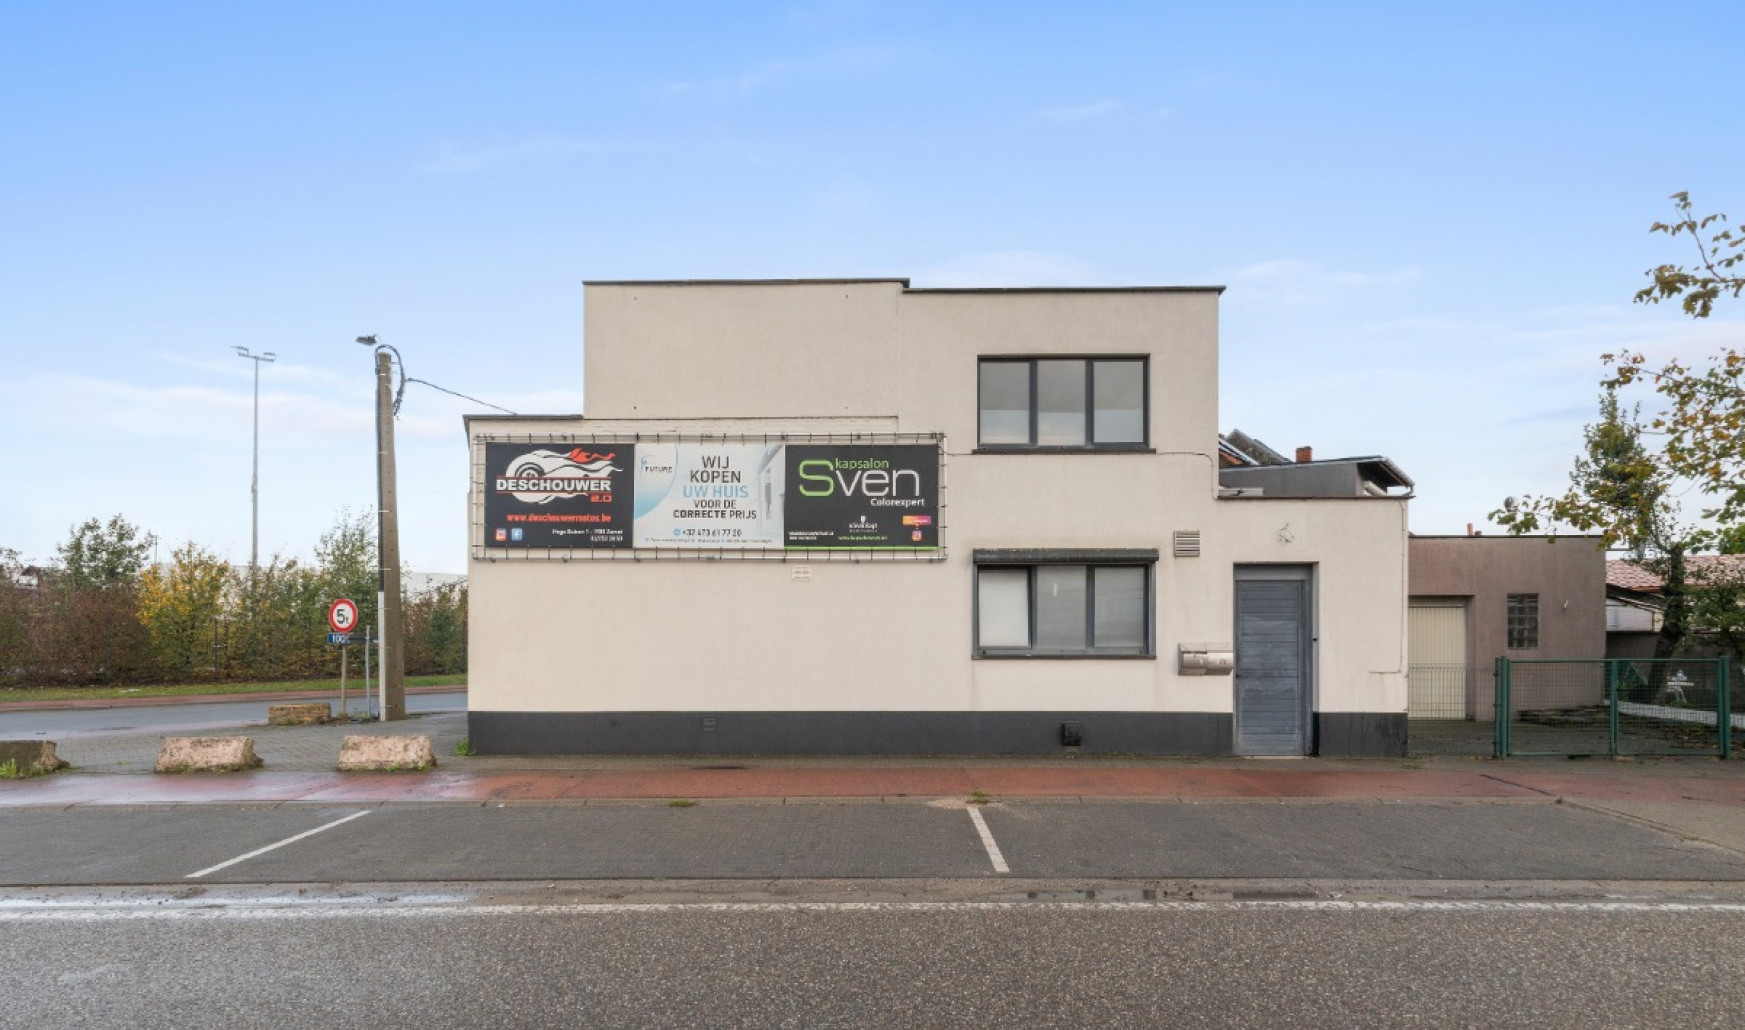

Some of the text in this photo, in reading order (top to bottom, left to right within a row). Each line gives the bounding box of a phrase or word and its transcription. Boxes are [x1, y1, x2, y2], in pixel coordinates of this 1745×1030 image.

[701, 455, 730, 469] WIJ
[835, 458, 889, 470] kapsalon
[690, 470, 741, 483] KOPEN
[799, 459, 920, 497] Sven
[496, 479, 612, 491] DESCHOUWER
[683, 485, 749, 498] UW HUIS
[590, 494, 612, 503] 2.0
[693, 500, 737, 509] VOOR DE
[870, 498, 926, 508] Colorexpert
[673, 510, 757, 520] CORRECTE PRIJS
[711, 529, 721, 537] 61
[722, 529, 731, 537] 77
